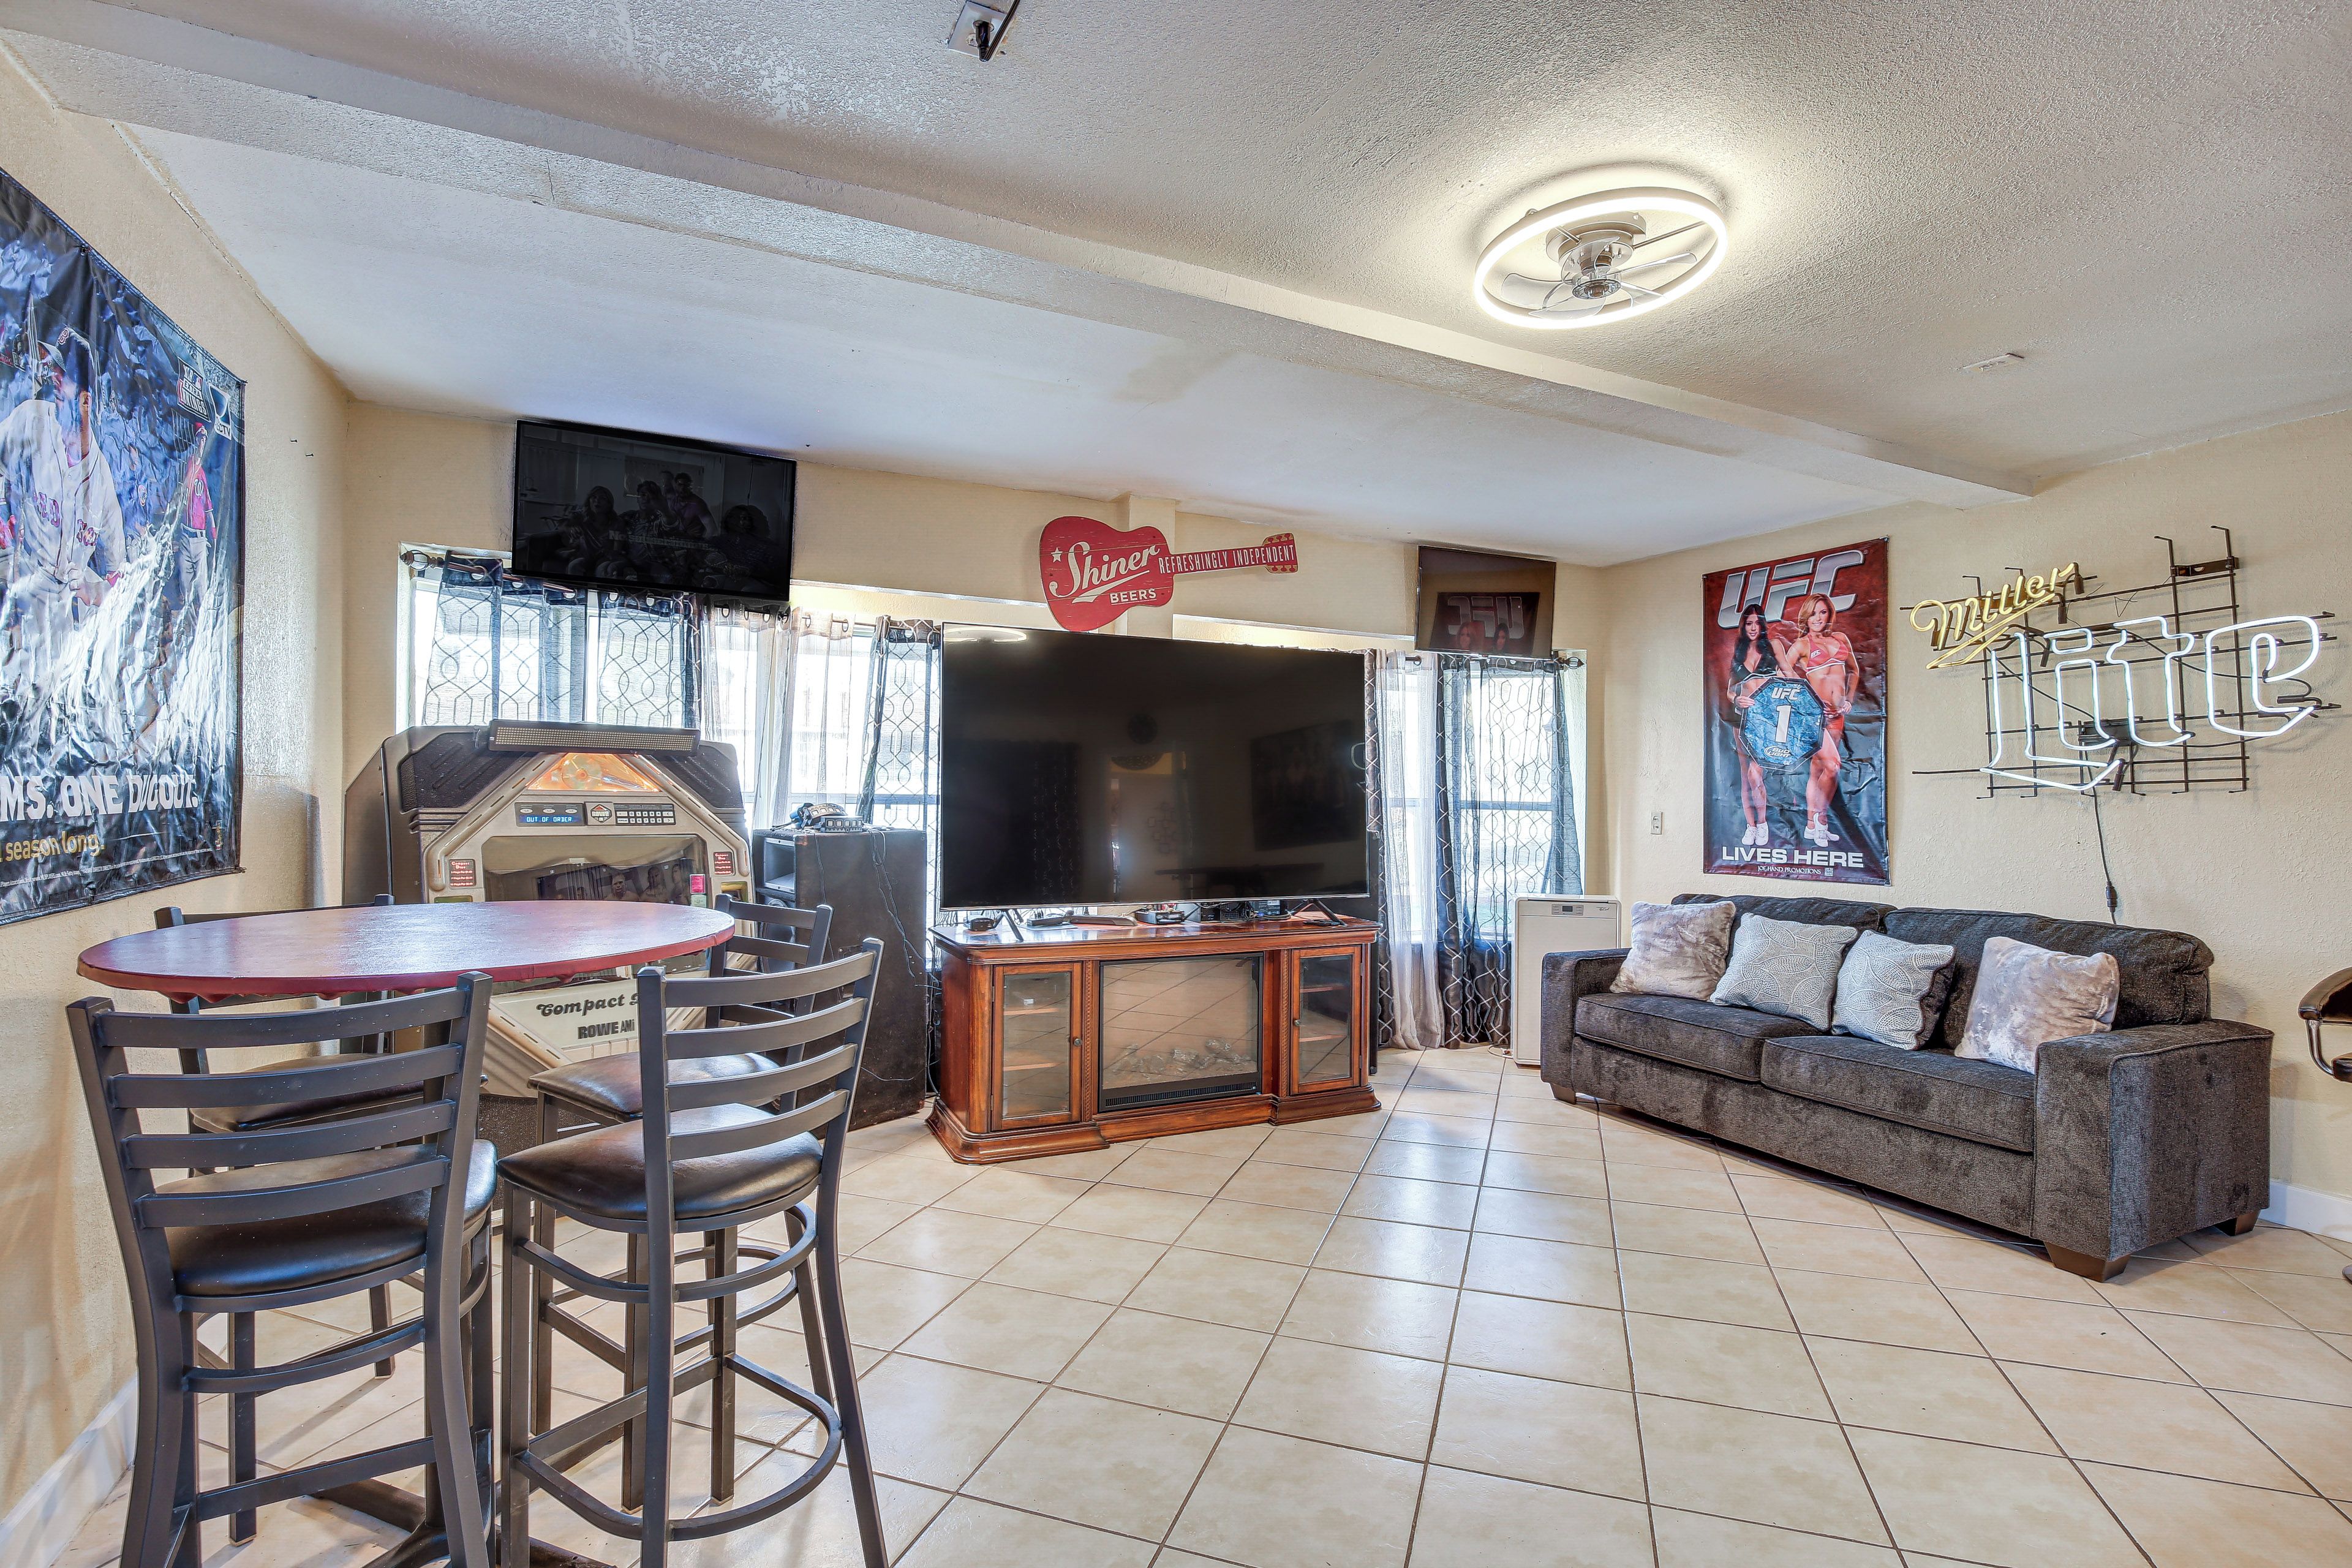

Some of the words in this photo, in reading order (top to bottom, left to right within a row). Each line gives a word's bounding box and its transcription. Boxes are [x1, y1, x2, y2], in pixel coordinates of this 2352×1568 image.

[180, 381, 207, 415] INNINGS
[184, 380, 203, 401] EXTRA
[1049, 541, 1161, 598] Shiner
[1158, 551, 1228, 575] REFRESHINGLY
[1232, 544, 1295, 567] INDEPENDENT
[1109, 588, 1157, 604] BEERS
[1717, 549, 1865, 629] UFC
[1910, 562, 2079, 651] Miller
[1771, 687, 1801, 700] UFC
[1775, 704, 1792, 744] 1
[61, 775, 123, 817] ONE
[126, 774, 199, 813] DUGOUT.
[6, 837, 61, 861] season
[62, 831, 106, 856] long.
[1722, 846, 1788, 864] LIVES
[1793, 850, 1864, 868] HERE
[536, 993, 625, 1017] Compact
[578, 1021, 619, 1039] ROWE
